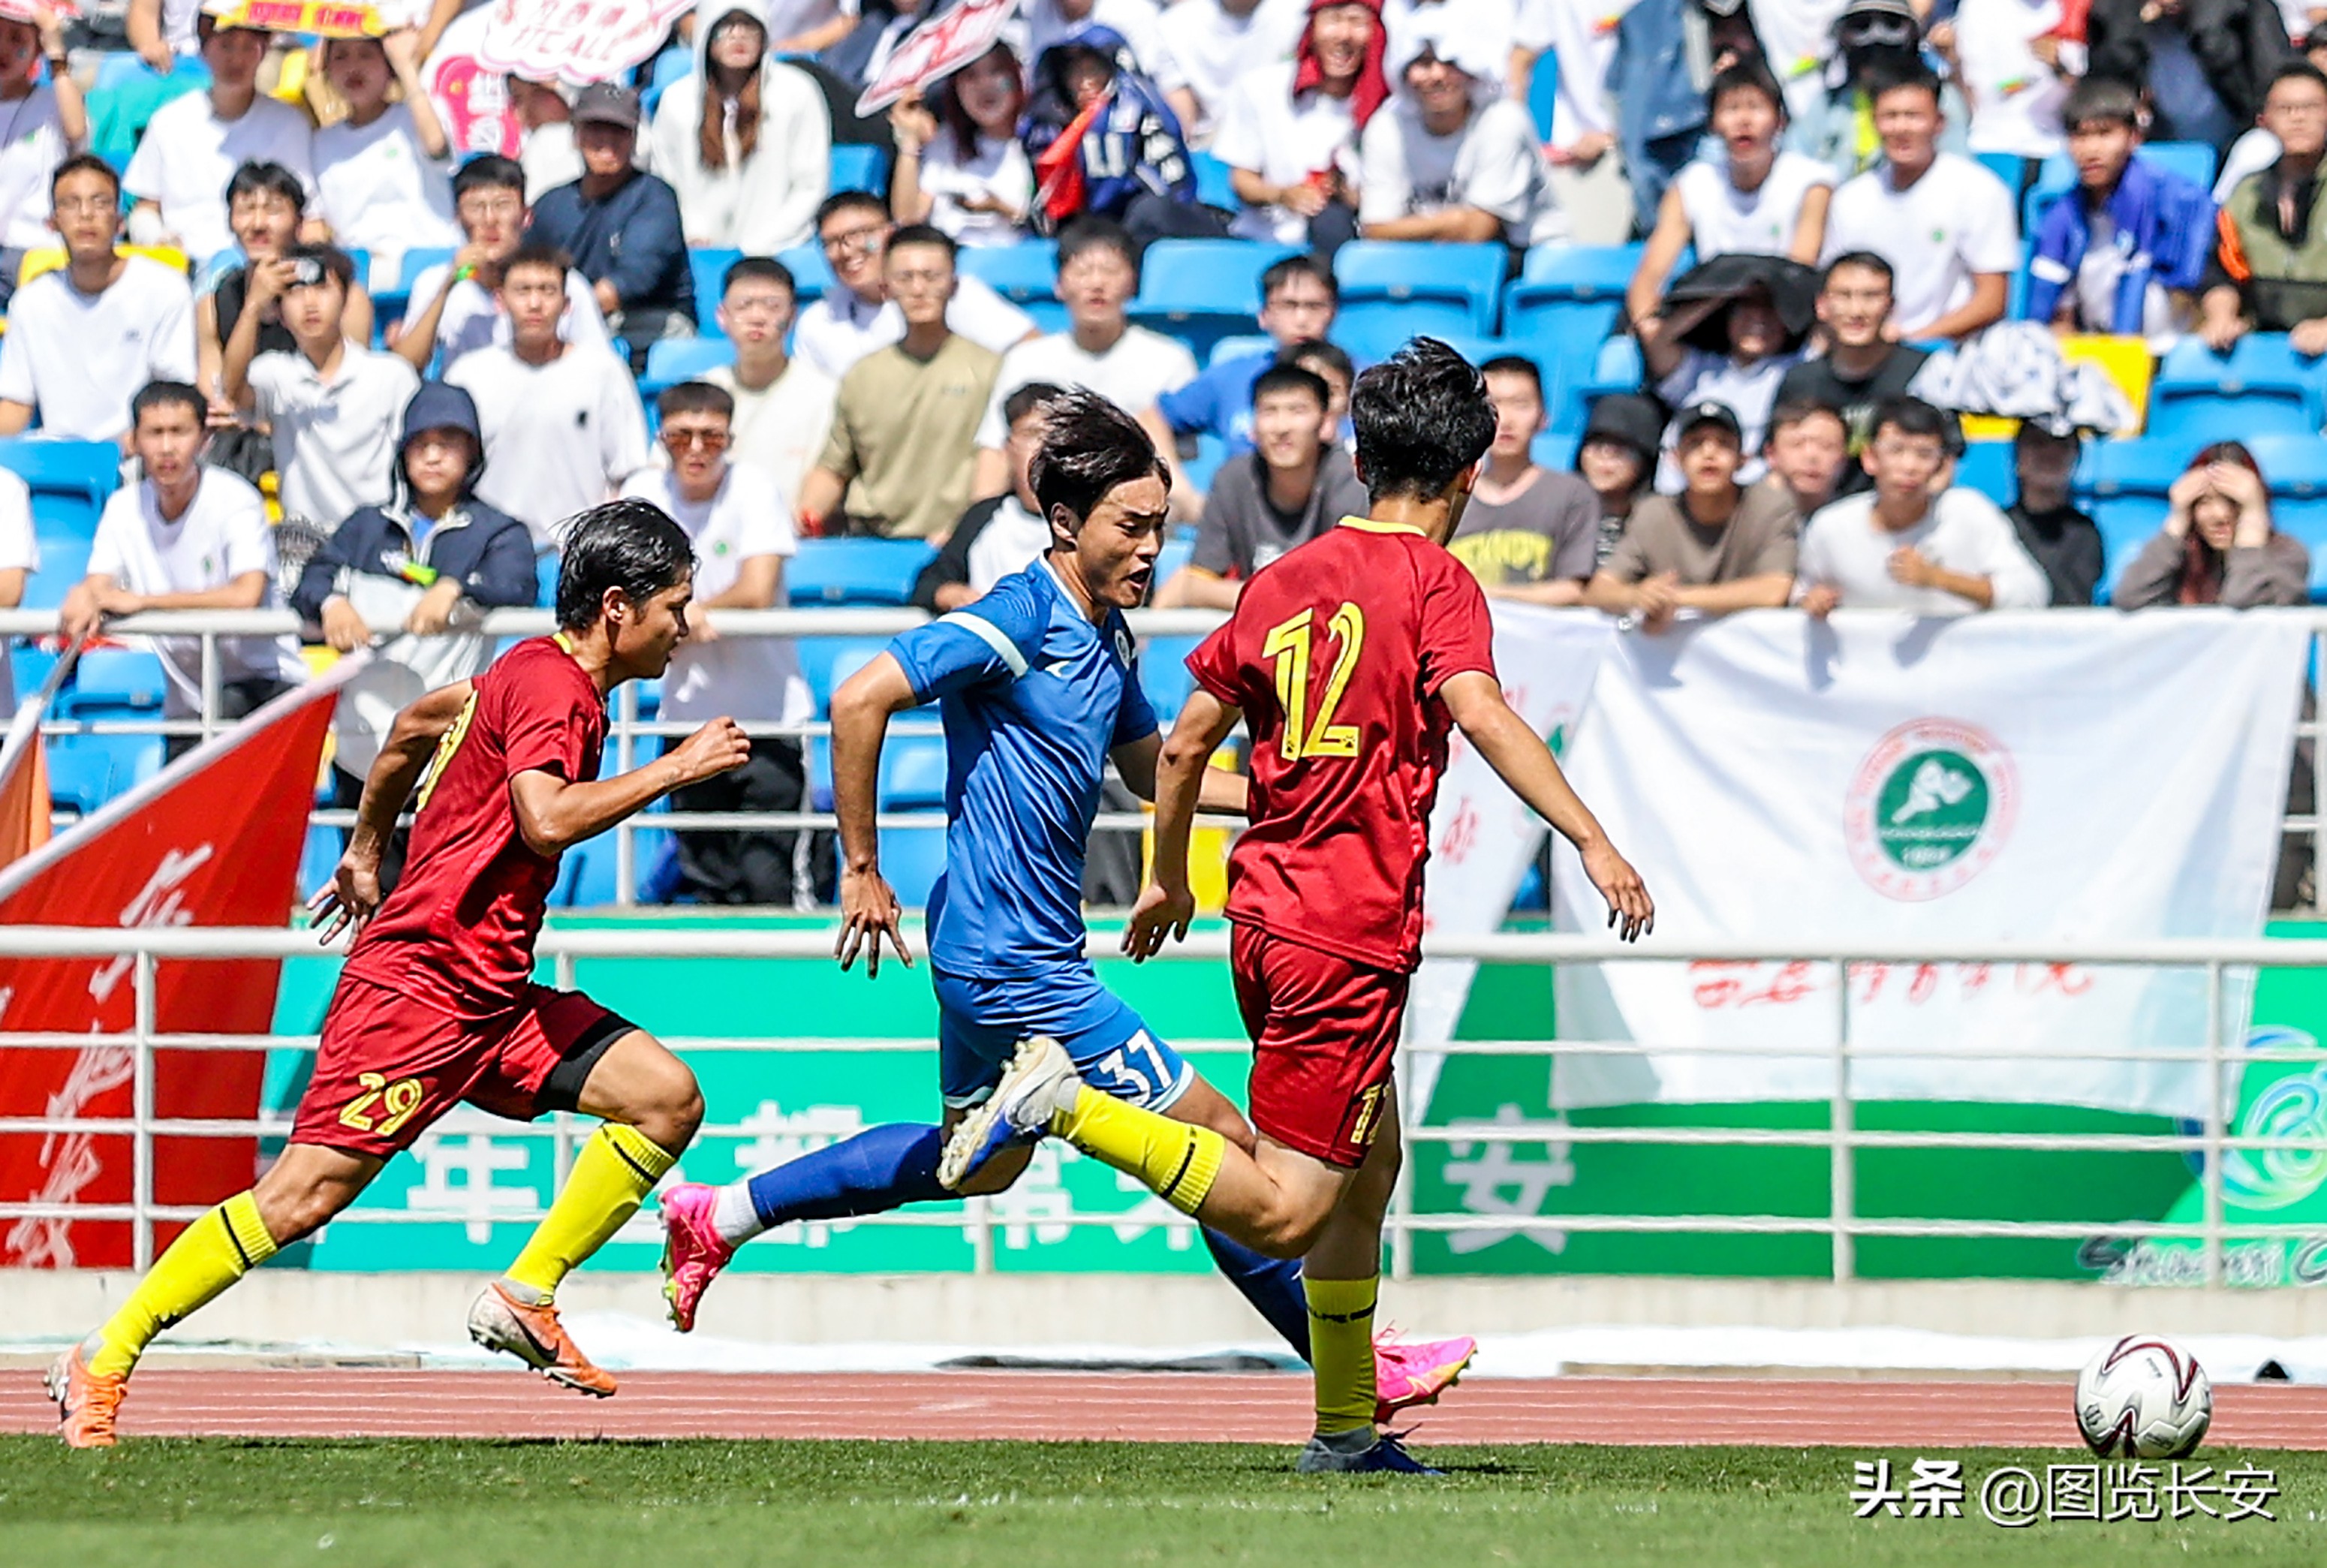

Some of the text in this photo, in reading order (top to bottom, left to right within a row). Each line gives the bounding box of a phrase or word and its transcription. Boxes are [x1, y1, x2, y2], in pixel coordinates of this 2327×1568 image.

[1262, 600, 1365, 762] 12
[339, 1072, 423, 1136] 29
[1098, 1028, 1173, 1107] 37
